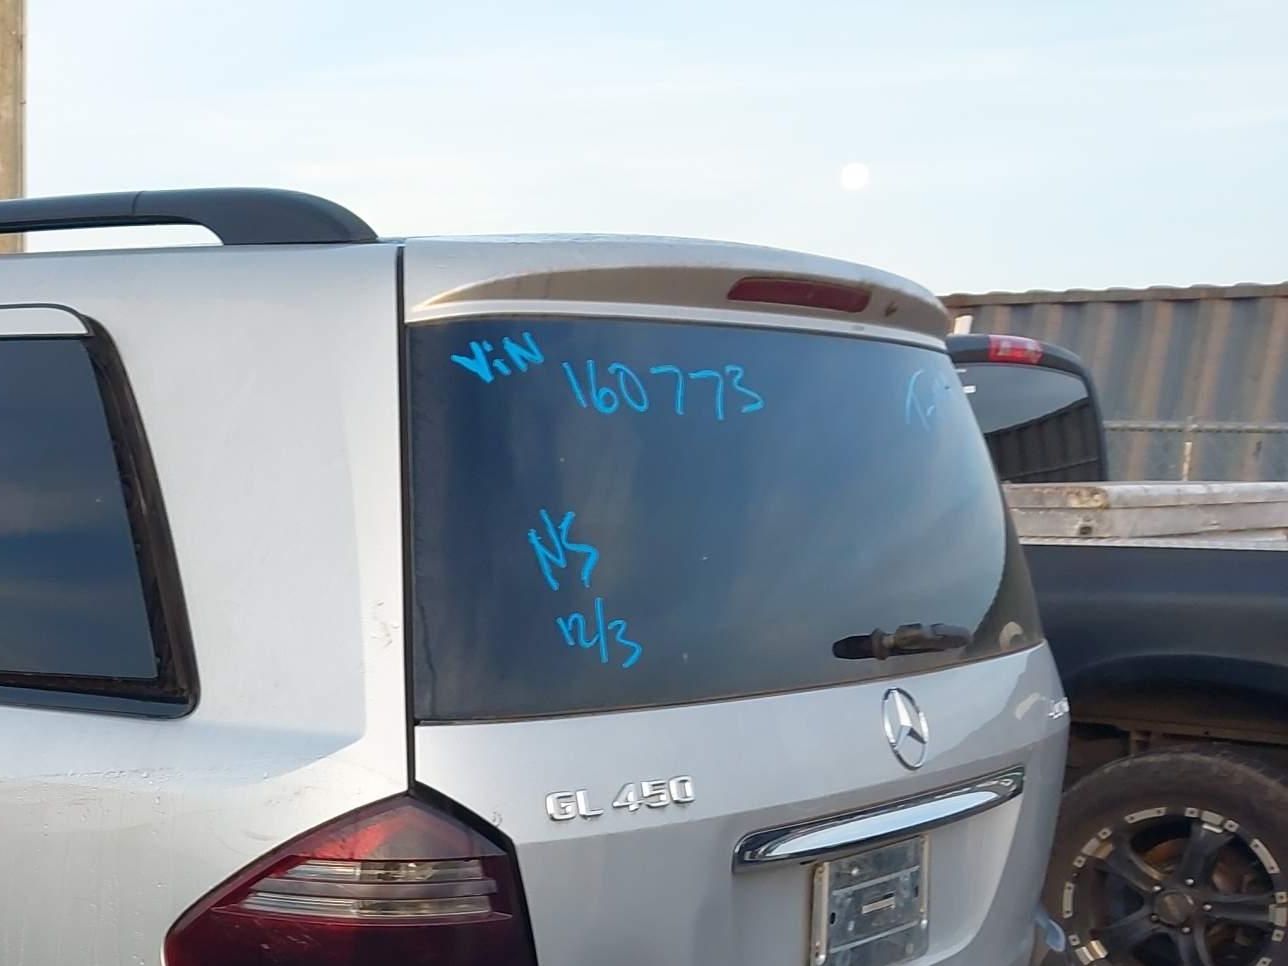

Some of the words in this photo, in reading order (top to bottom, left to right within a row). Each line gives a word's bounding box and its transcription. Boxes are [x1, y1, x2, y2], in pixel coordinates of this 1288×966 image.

[561, 358, 766, 420] 160773
[556, 597, 643, 668] 12/3
[546, 788, 605, 822] GL
[611, 774, 696, 813] 450
